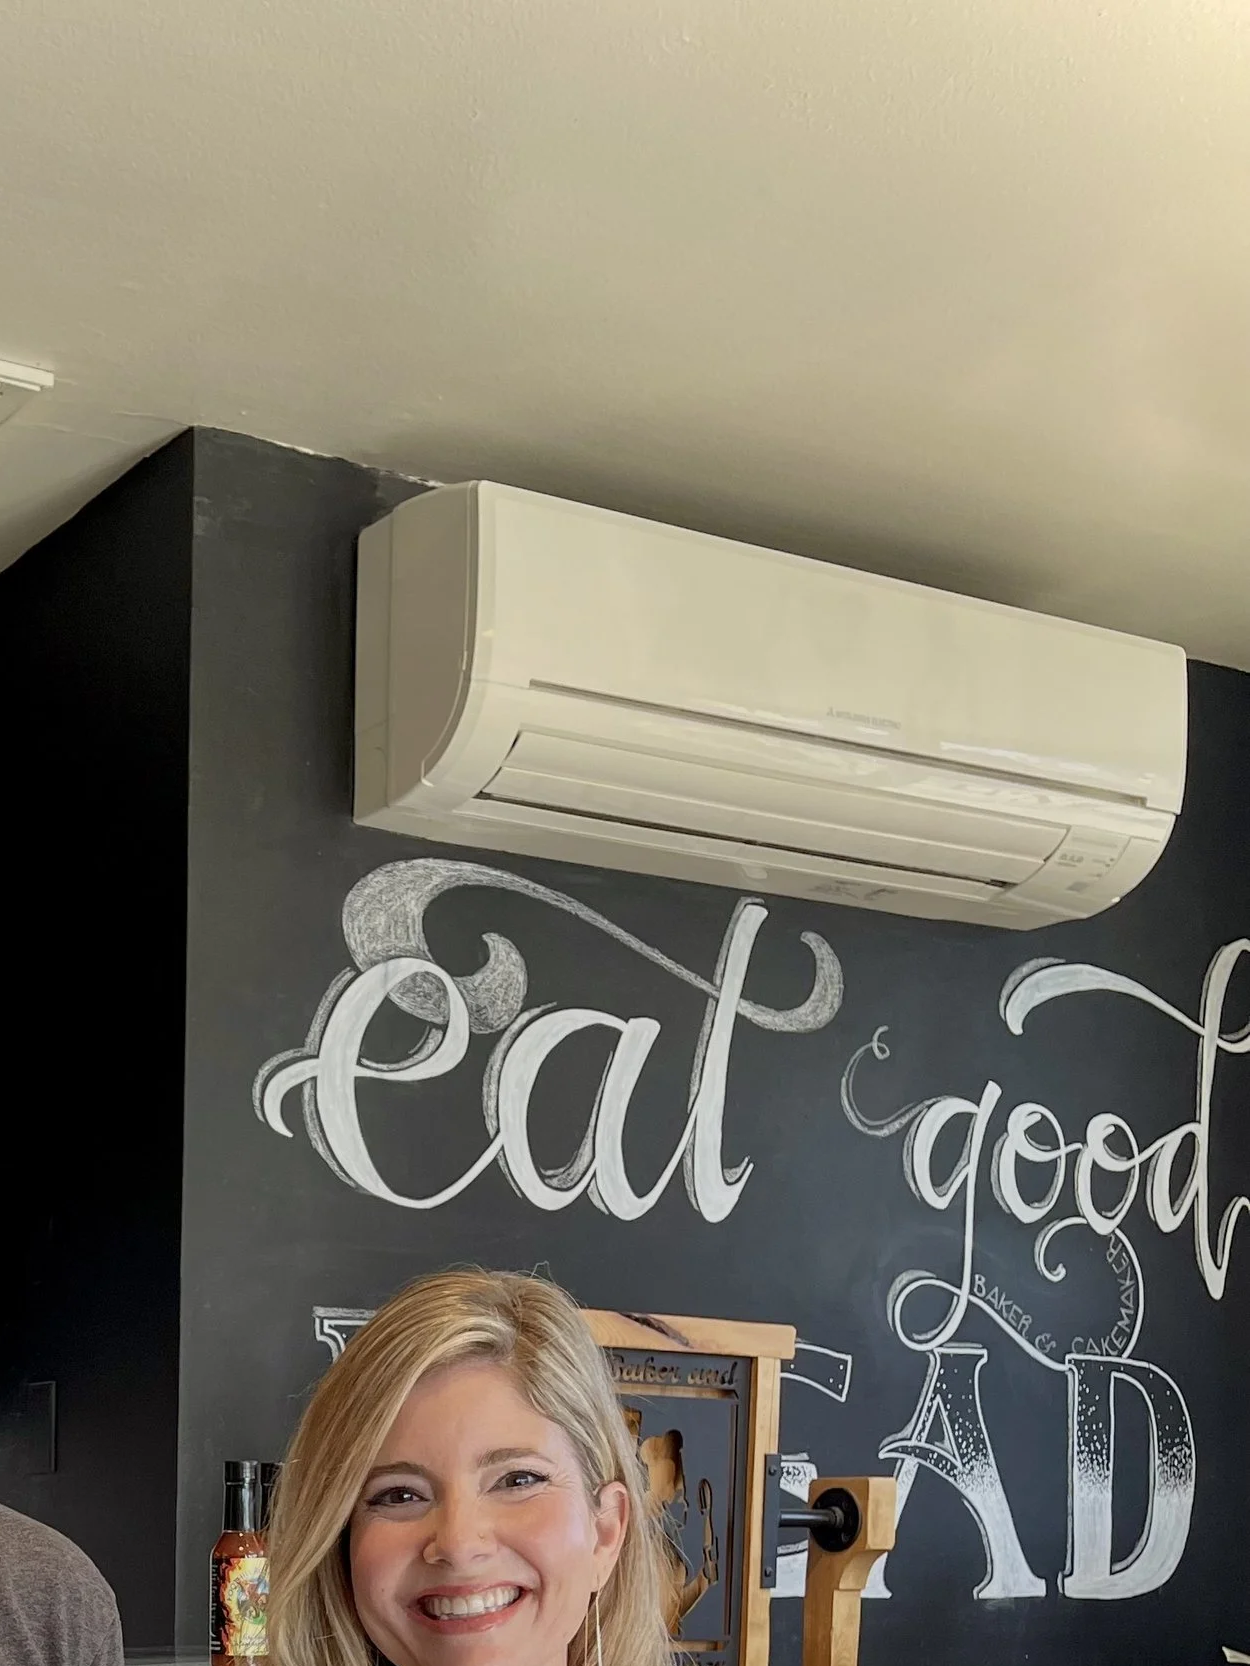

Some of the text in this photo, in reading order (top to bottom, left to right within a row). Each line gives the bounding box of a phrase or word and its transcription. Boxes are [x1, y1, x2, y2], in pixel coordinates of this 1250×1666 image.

[890, 938, 1250, 1352] good
[974, 1274, 1033, 1340] BAKER
[1071, 1234, 1136, 1357] CAKEMAKER
[687, 1361, 739, 1386] and
